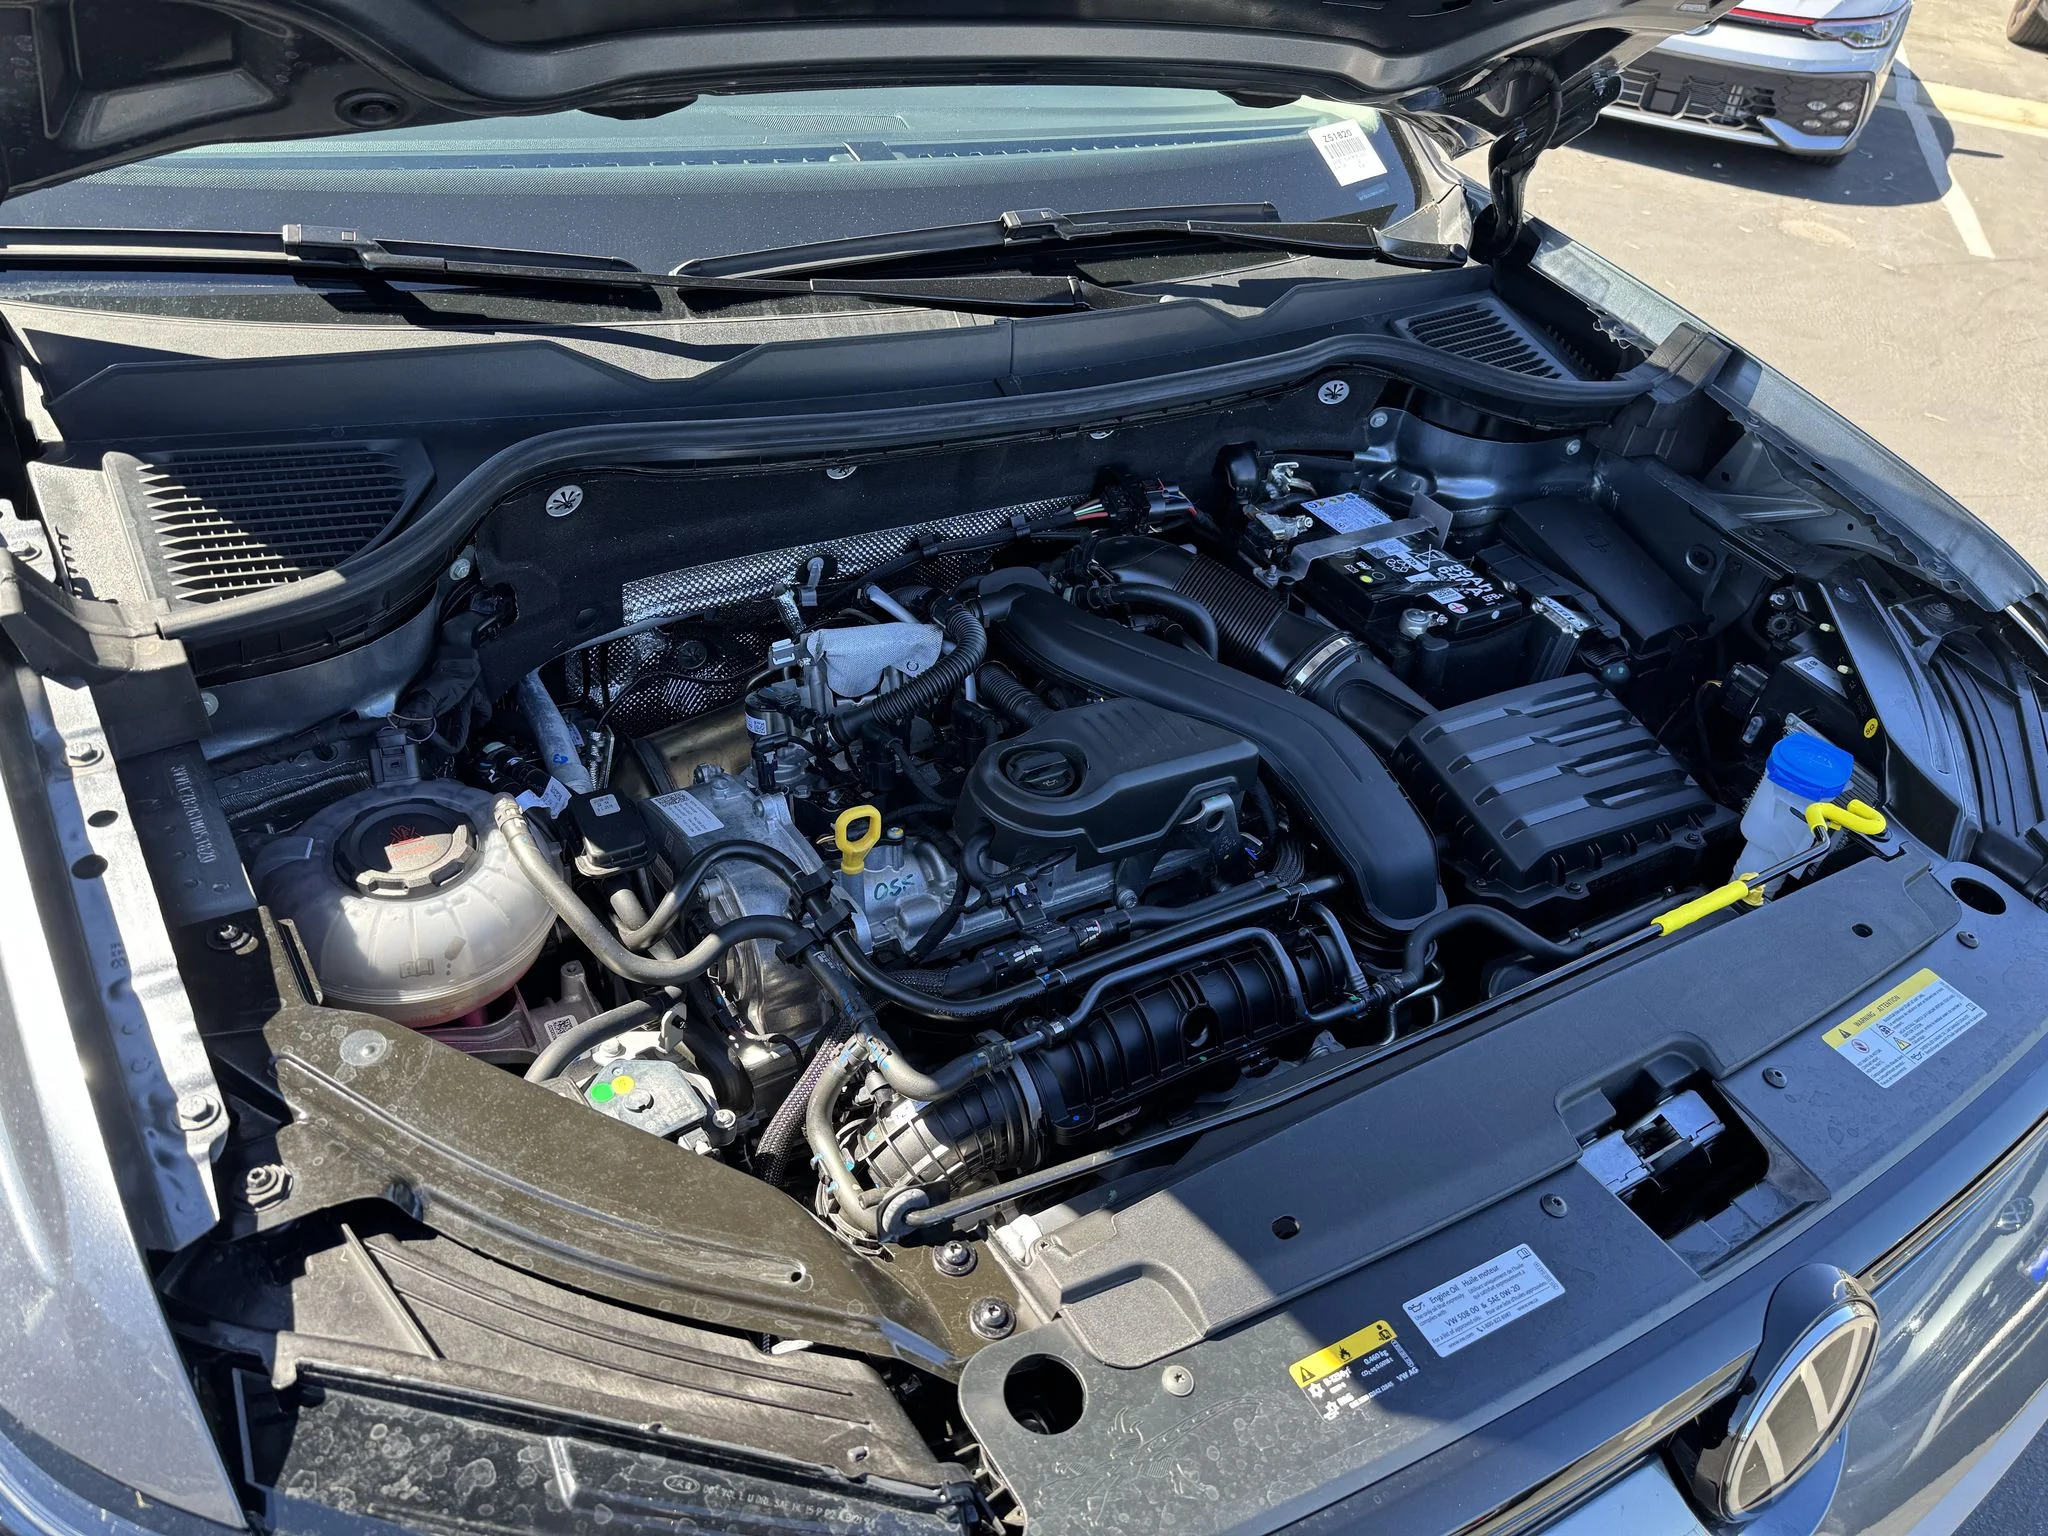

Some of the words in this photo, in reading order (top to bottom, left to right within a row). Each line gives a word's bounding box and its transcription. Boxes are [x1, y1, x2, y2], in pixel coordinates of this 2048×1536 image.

[1853, 1011, 1877, 1027] WARNING
[1876, 994, 1901, 1012] ATTENTION
[1462, 1275, 1479, 1287] Huile
[1477, 1265, 1500, 1279] moteur
[1429, 1290, 1452, 1305] Engine
[1449, 1285, 1460, 1293] Oil
[1445, 1316, 1459, 1327] VW
[1457, 1310, 1471, 1320] 508
[1469, 1305, 1480, 1314] 00
[1487, 1295, 1501, 1305] SAE
[1499, 1284, 1521, 1299] 0W-20
[1418, 1314, 1438, 1327] complies
[1436, 1309, 1447, 1317] with
[1363, 1353, 1380, 1365] 0.460
[1378, 1348, 1389, 1358] kg
[1396, 1371, 1410, 1382] VW
[1408, 1366, 1419, 1375] AG
